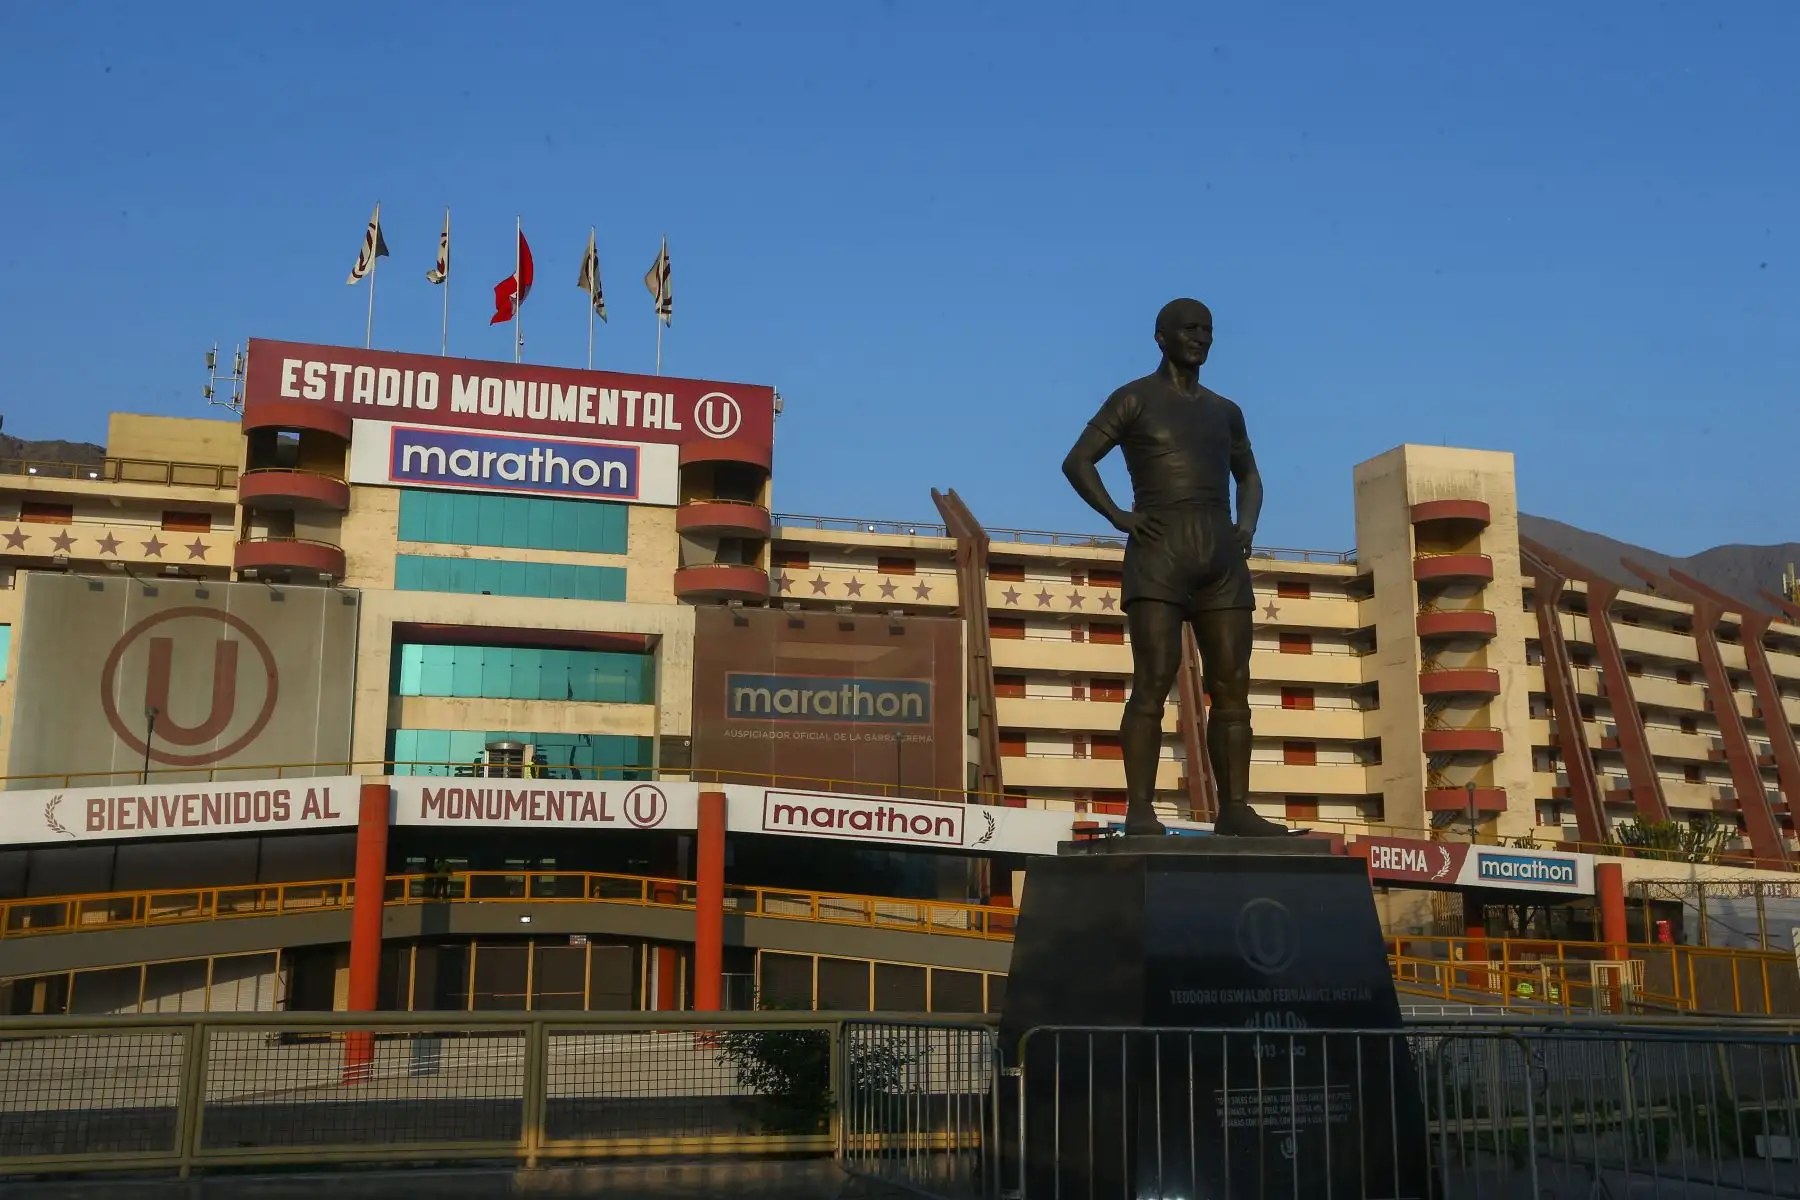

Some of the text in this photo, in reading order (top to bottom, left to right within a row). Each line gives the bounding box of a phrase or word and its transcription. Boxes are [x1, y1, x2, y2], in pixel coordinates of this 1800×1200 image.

[280, 358, 682, 431] ESTADIO MONUMENTAL
[401, 443, 629, 489] marathon
[734, 682, 924, 718] marathon
[724, 729, 790, 739] AUSPICIADOR
[792, 731, 831, 741] OFICIAL
[833, 733, 847, 741] DE
[849, 733, 861, 741] LA
[85, 787, 341, 832] BIENVENIDOS AL
[420, 787, 616, 822] MONUMENTAL
[773, 800, 955, 838] marathon
[1370, 845, 1428, 873] CREMA
[1482, 858, 1573, 881] marathon
[1169, 989, 1218, 1005] TEODORO
[1219, 988, 1271, 1004] OSWALDO
